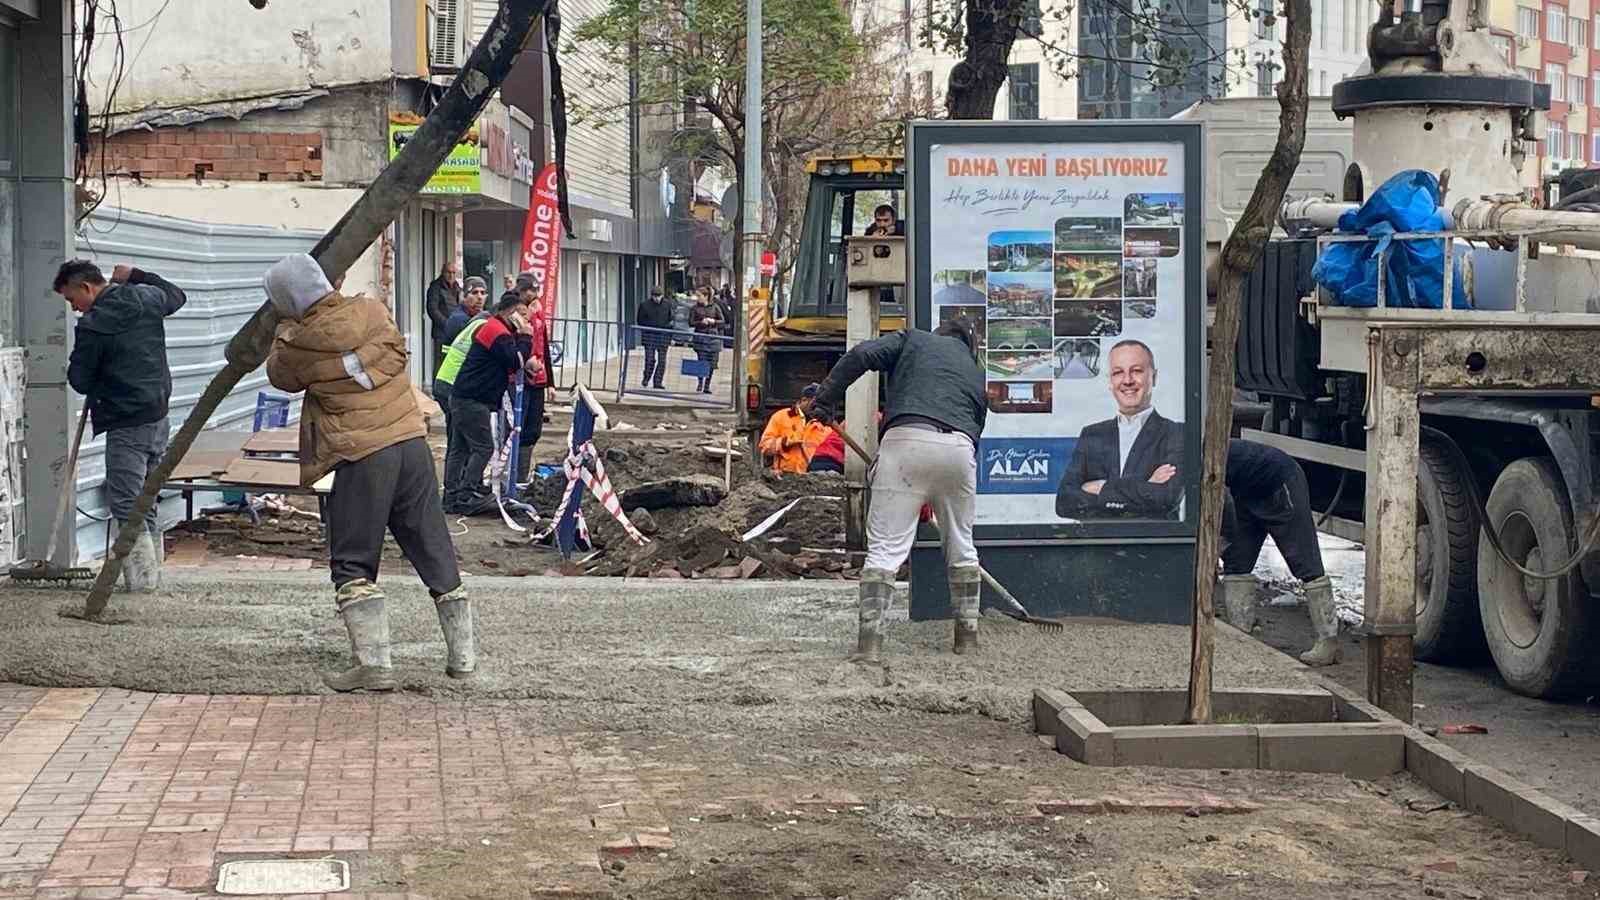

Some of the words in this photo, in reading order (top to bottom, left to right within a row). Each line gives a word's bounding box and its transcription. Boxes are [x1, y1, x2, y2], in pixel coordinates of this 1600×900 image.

[948, 157, 999, 177] DAHA
[1006, 154, 1047, 177] YENİ
[1055, 157, 1168, 181] BAŞLIYORUZ
[945, 186, 971, 205] Hep
[972, 186, 1019, 206] Birlikte
[1021, 186, 1050, 210] Yeni
[1050, 187, 1112, 207] Zonguldak
[990, 460, 1049, 475] ALAN
